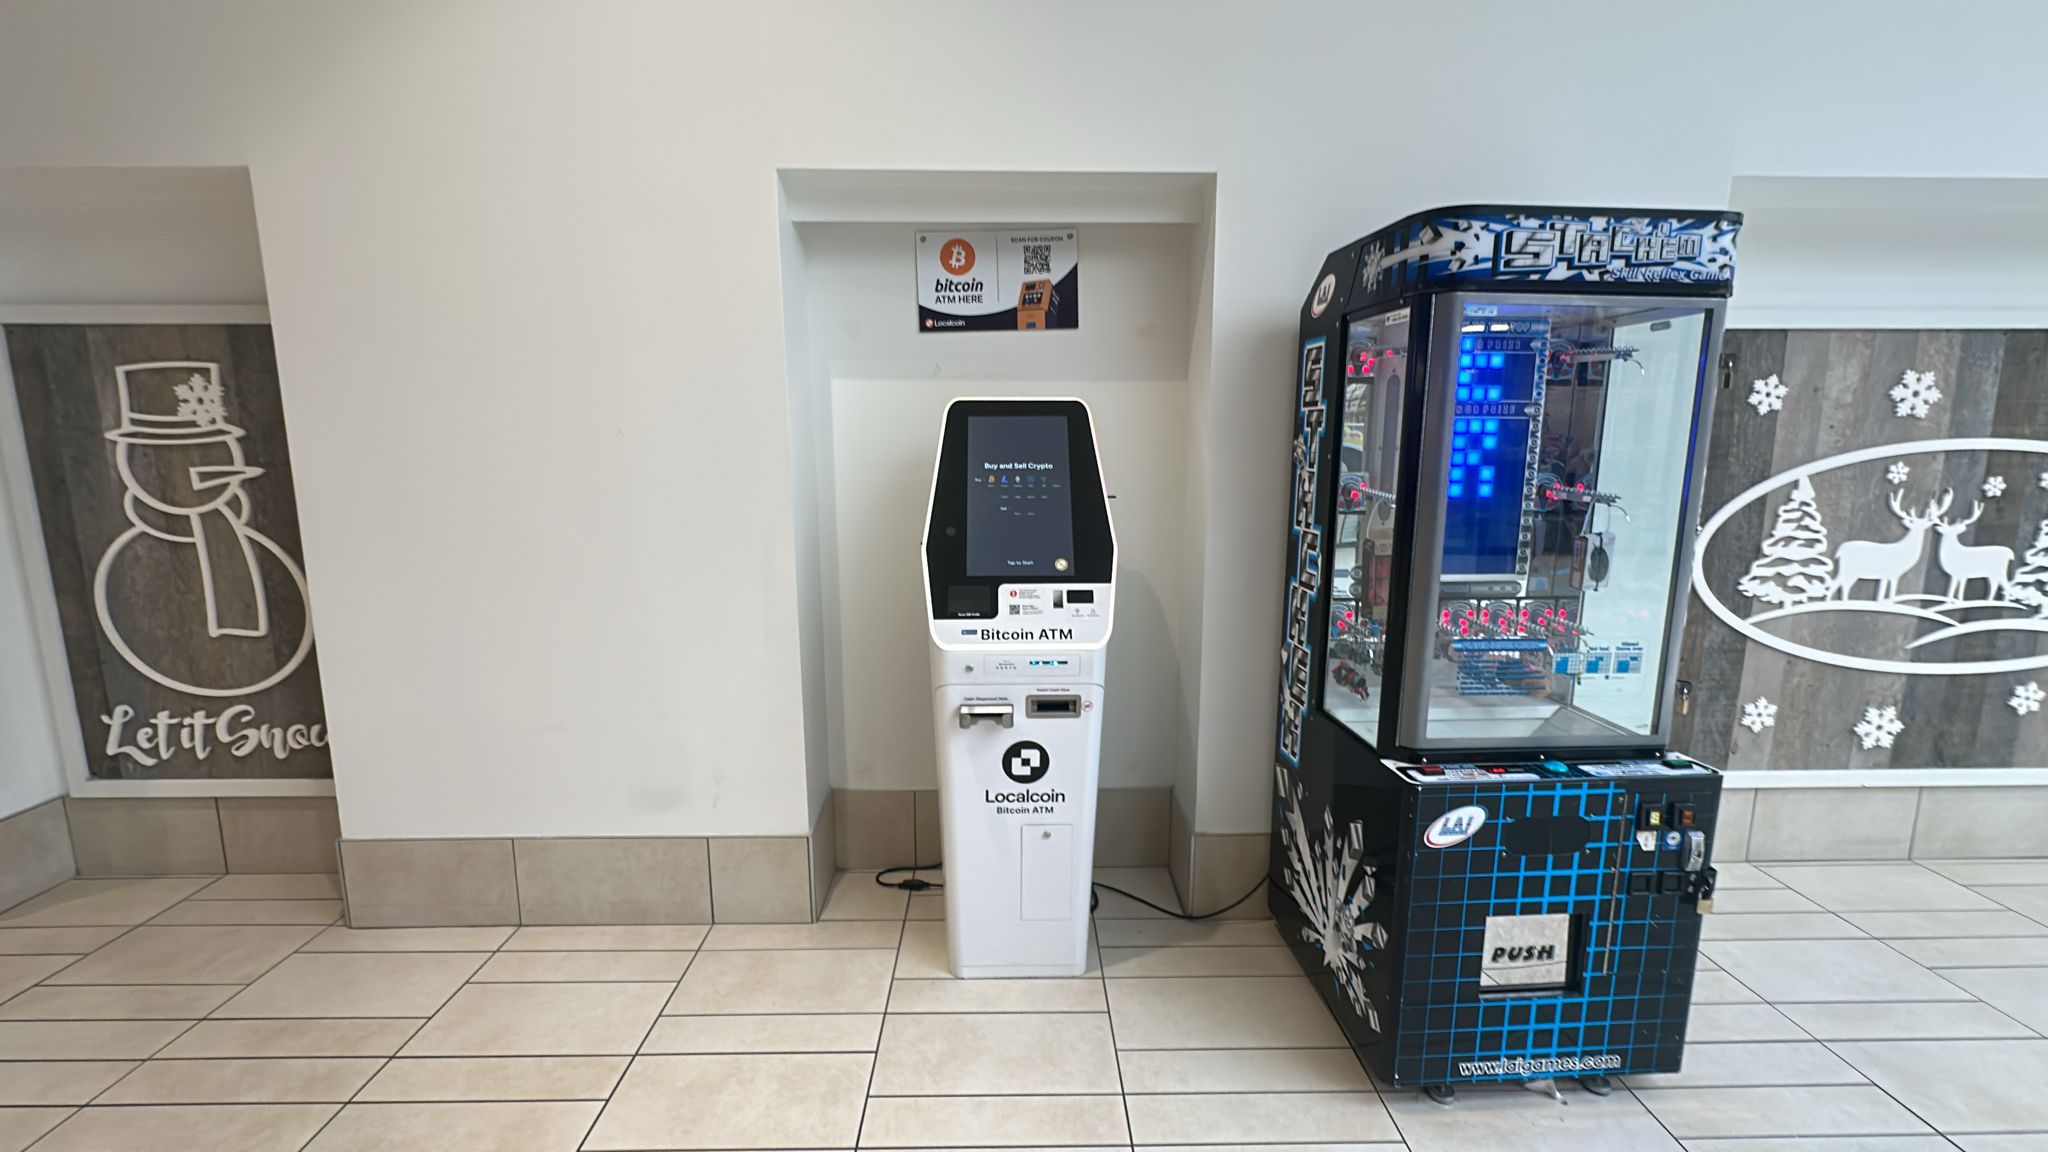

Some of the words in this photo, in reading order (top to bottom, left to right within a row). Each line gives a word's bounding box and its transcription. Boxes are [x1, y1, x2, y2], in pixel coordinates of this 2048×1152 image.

[1612, 266, 1639, 280] Skill
[1645, 267, 1687, 280] Reflex
[1690, 268, 1727, 281] Game
[935, 278, 984, 293] bitcoin
[935, 295, 956, 304] ATM
[958, 294, 983, 304] HERE
[934, 319, 966, 328] Localcoin
[984, 462, 998, 470] Buy
[1028, 462, 1053, 470] Crypto
[981, 628, 1034, 640] Bitcoin
[1038, 628, 1073, 640] ATM
[100, 704, 181, 767] Let
[179, 710, 218, 760] it
[985, 788, 1066, 803] Localcoin
[996, 806, 1030, 814] Bitcoin
[1032, 806, 1054, 814] ATM
[1491, 944, 1555, 962] PUSH
[1458, 1054, 1622, 1076] www.laigames.com
